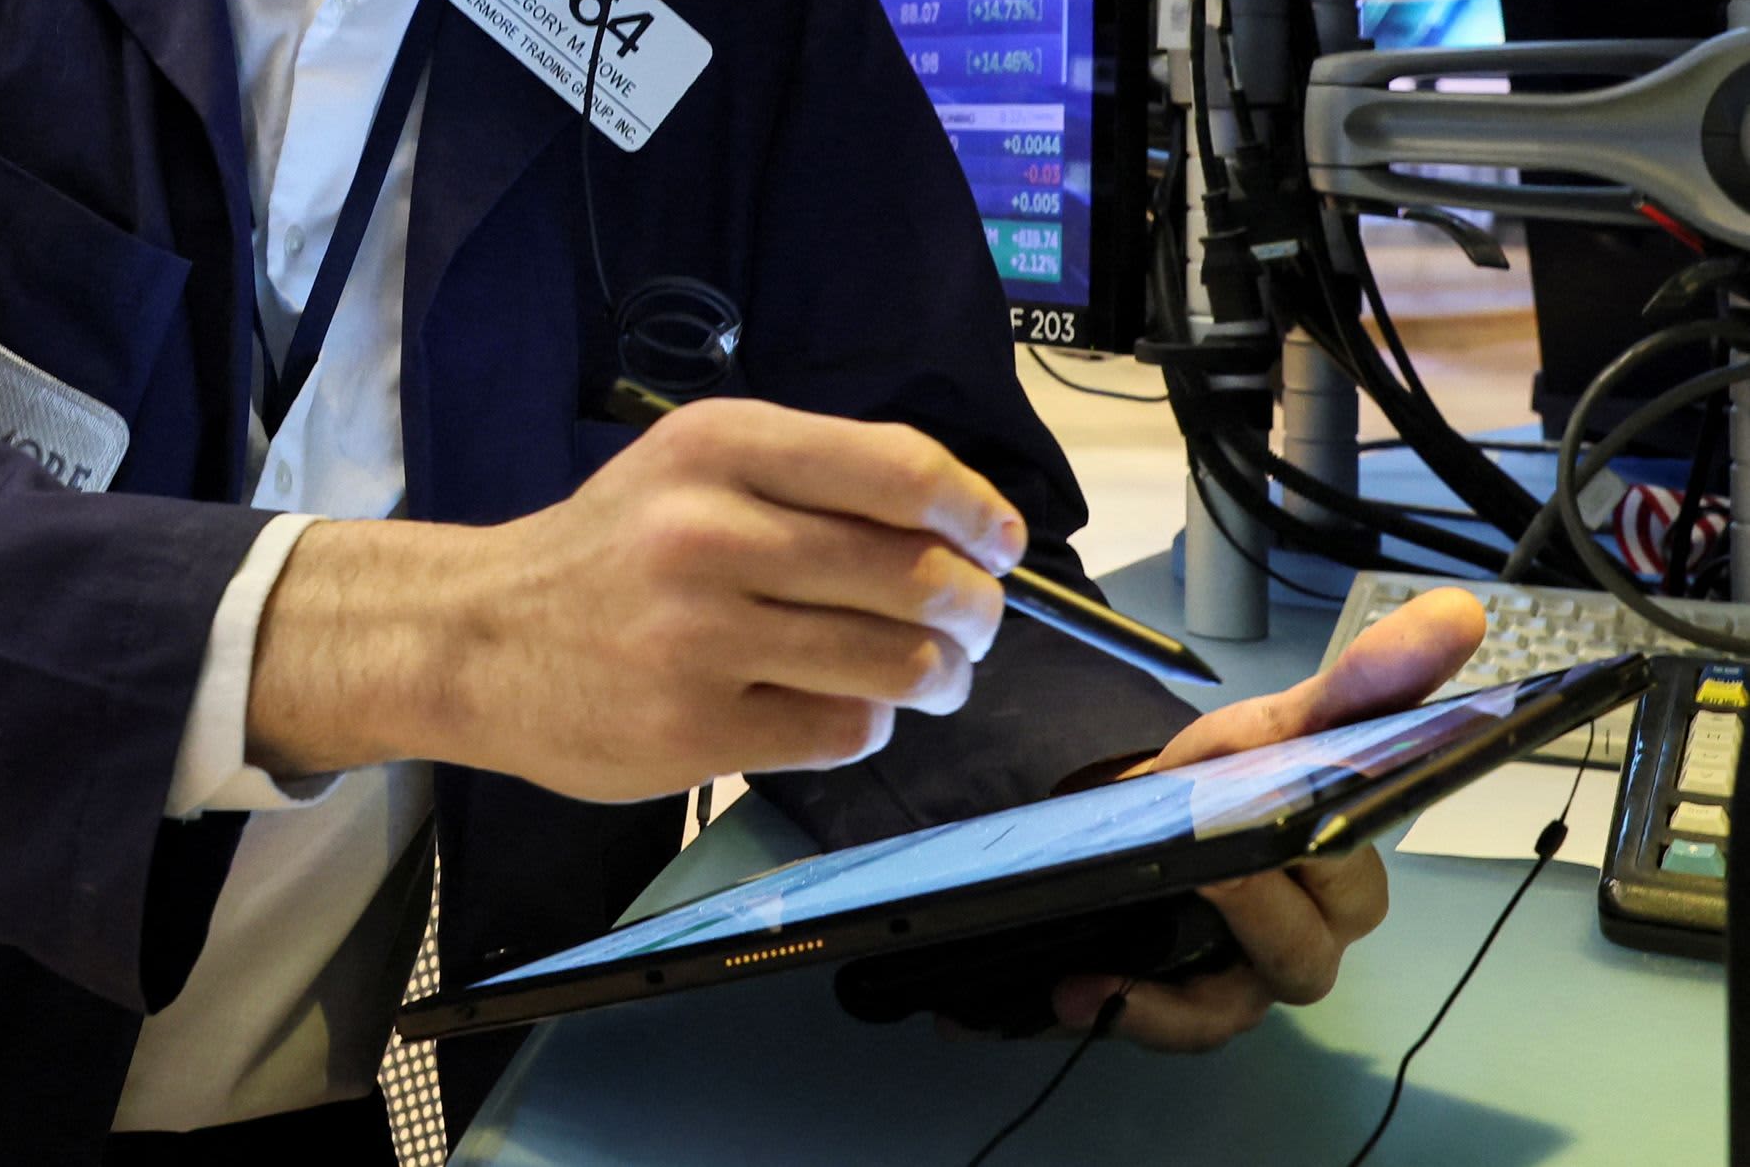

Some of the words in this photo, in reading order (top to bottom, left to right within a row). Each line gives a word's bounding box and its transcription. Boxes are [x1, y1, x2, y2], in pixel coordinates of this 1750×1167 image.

[566, 33, 587, 59] M.
[520, 34, 572, 85] TRADING
[614, 117, 637, 145] INC.
[1004, 134, 1061, 155] +0.0044
[1012, 192, 1061, 214] +0.005
[1030, 309, 1076, 343] 203
